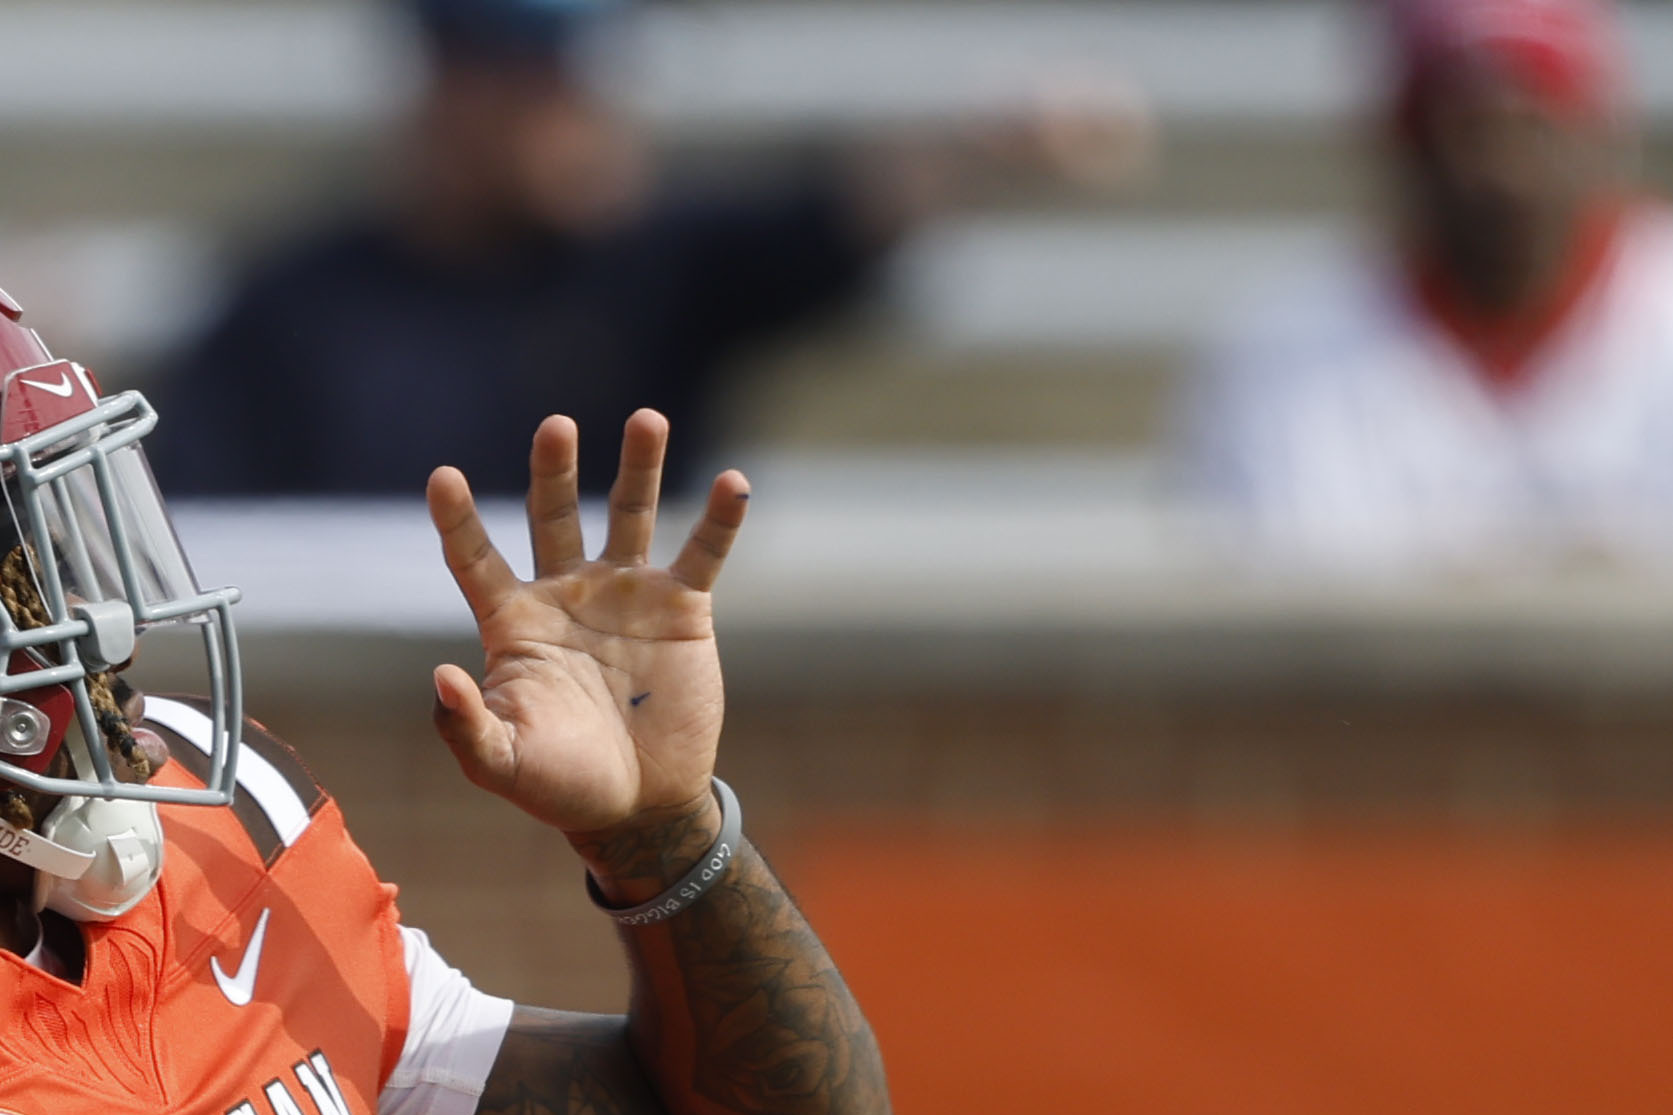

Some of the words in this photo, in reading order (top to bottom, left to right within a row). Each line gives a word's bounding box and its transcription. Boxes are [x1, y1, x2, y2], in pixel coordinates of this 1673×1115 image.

[701, 842, 732, 881] GOD
[679, 881, 702, 900] IS
[618, 897, 681, 926] BIGGE
